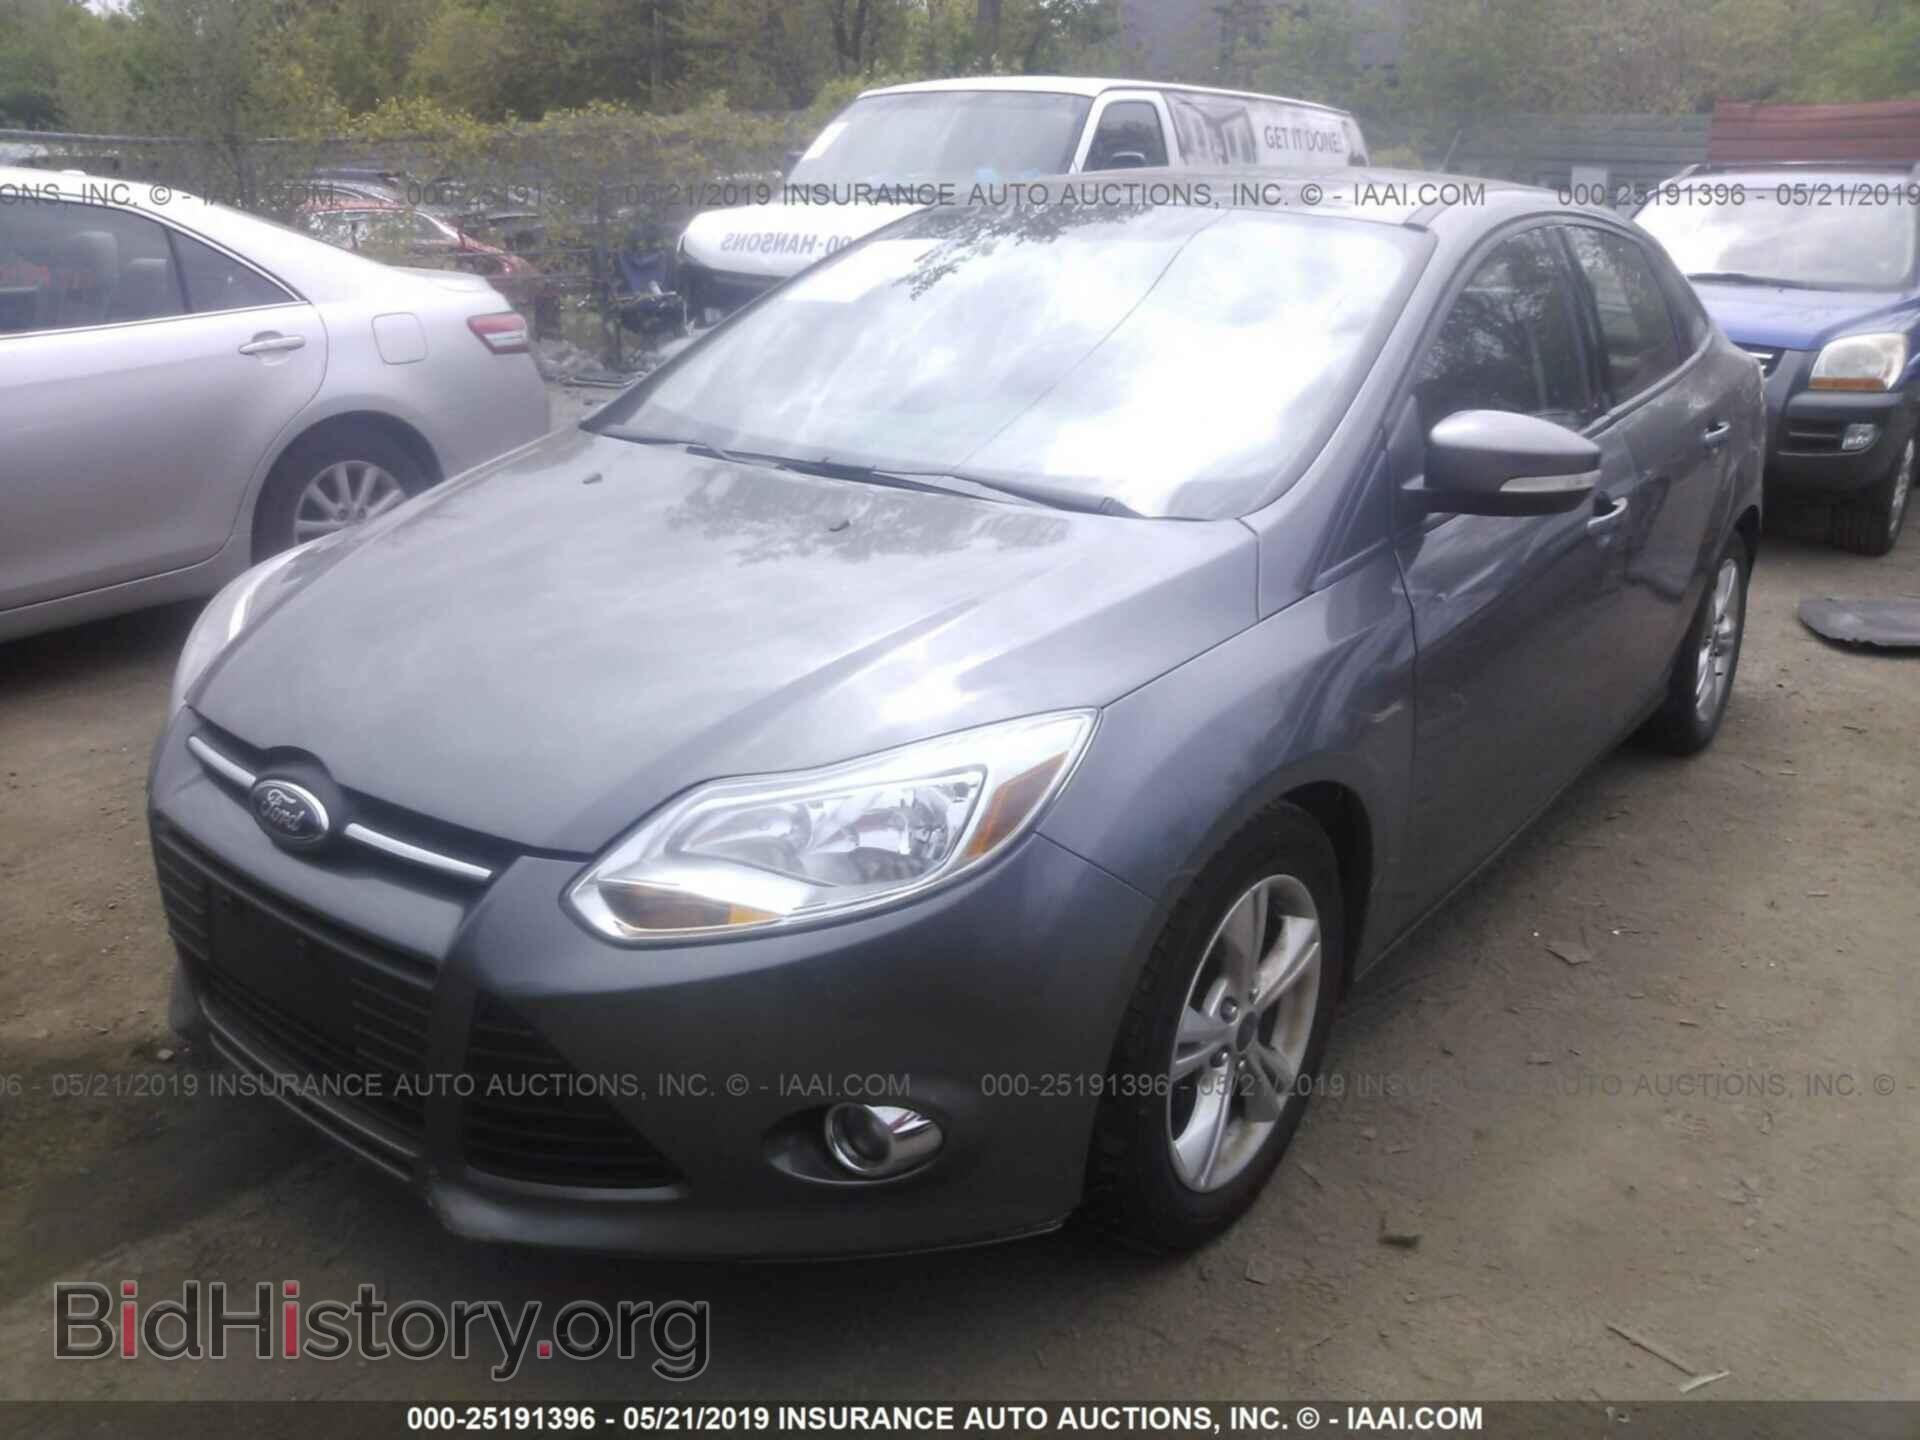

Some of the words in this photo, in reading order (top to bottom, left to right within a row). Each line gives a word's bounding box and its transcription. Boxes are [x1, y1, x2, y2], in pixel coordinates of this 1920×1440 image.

[1263, 125, 1289, 150] GET
[1291, 127, 1303, 151] IT
[261, 788, 305, 831] Ford
